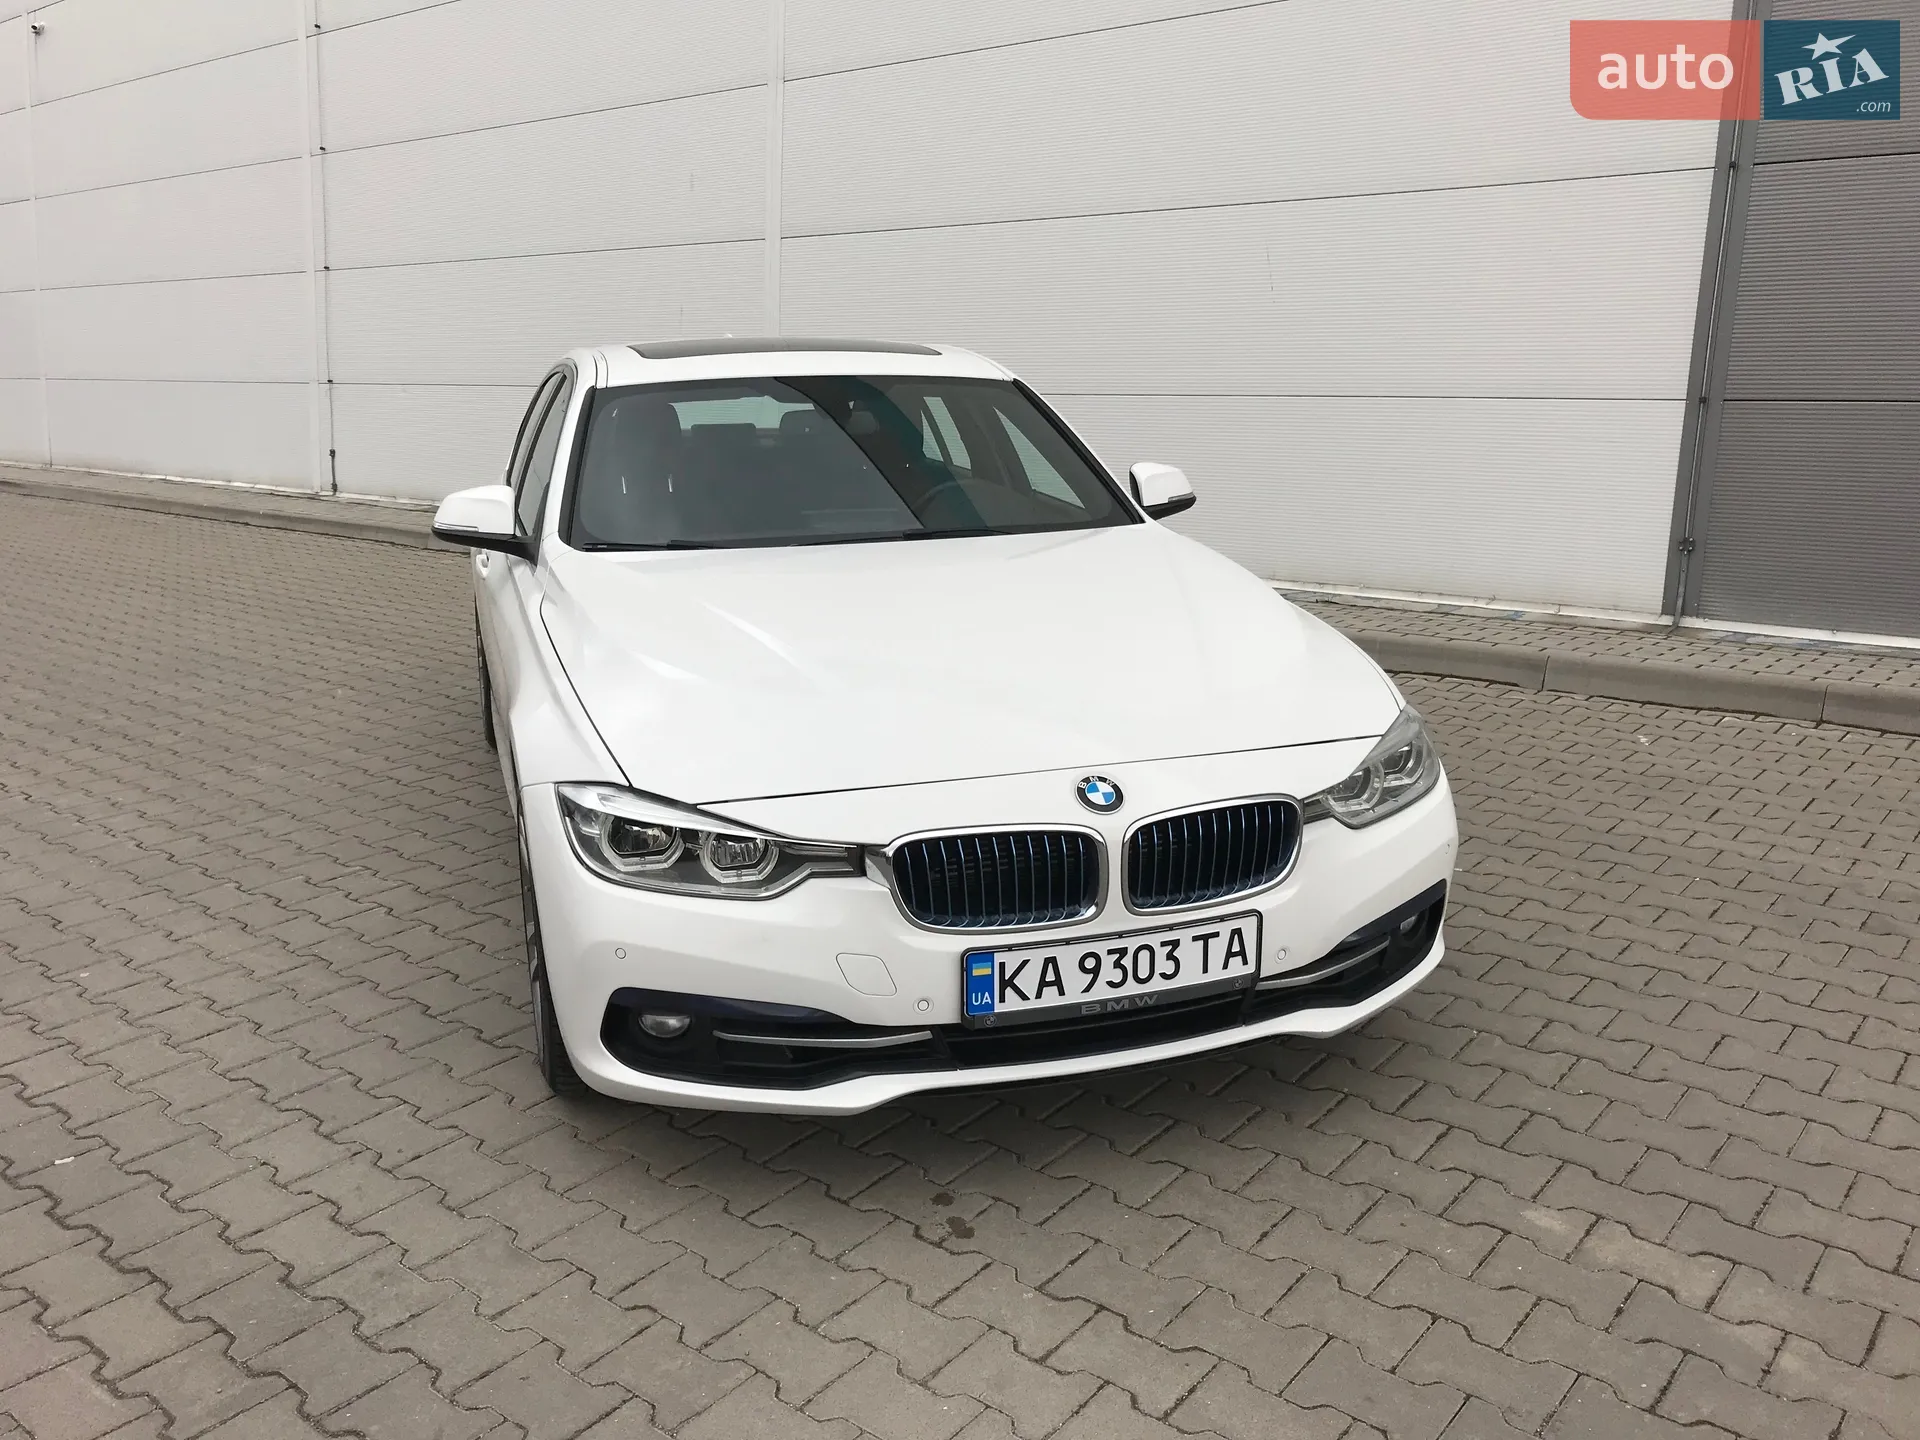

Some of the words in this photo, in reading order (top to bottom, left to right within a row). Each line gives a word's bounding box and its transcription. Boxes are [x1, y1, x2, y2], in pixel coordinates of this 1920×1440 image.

[1078, 776, 1115, 789] BMW
[998, 956, 1066, 1004] KA
[1078, 938, 1181, 994] 9303
[1191, 926, 1249, 975] TA
[971, 992, 992, 1006] UA
[1080, 994, 1159, 1015] BMW
